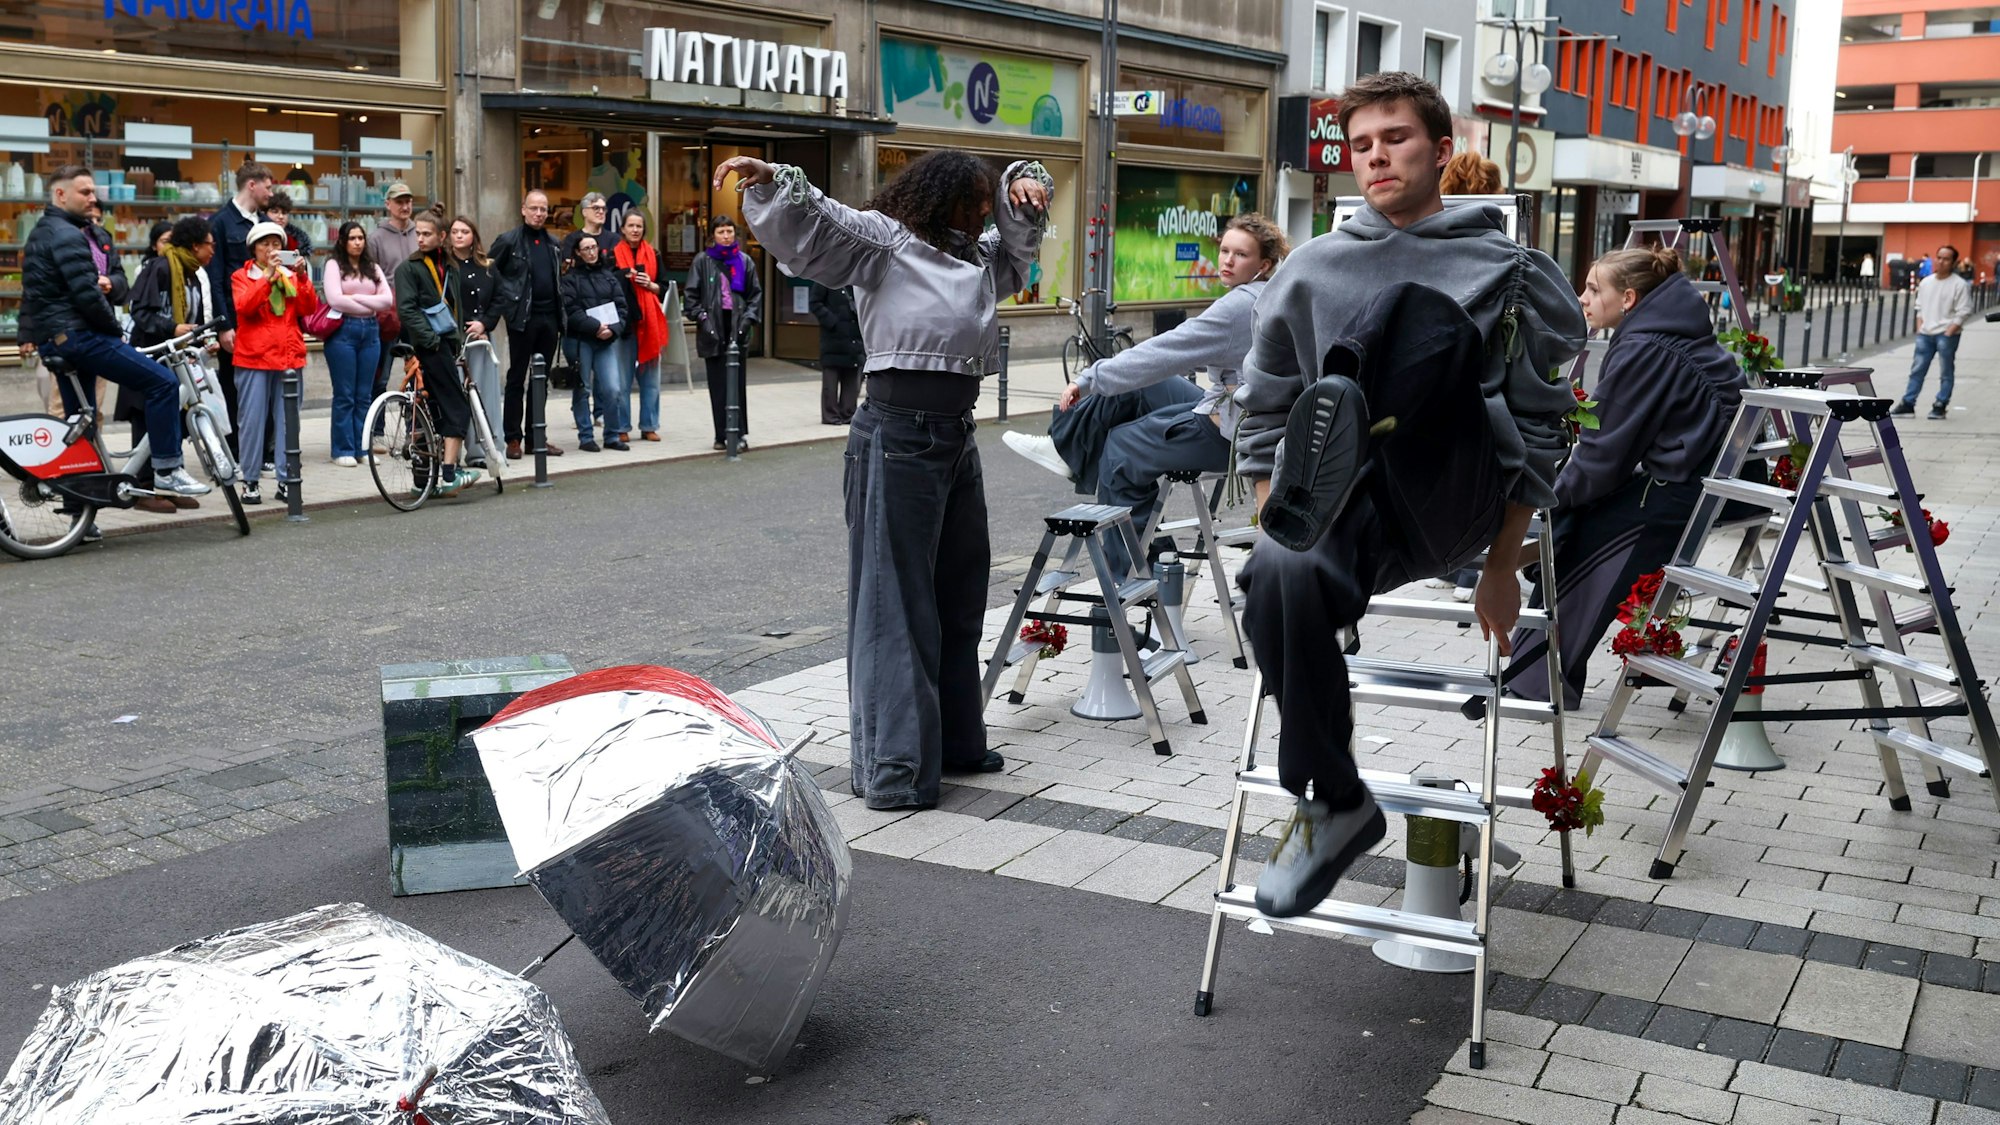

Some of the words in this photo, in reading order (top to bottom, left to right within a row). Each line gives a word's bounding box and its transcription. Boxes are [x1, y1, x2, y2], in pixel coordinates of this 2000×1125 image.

[648, 27, 848, 98] NATURATA
[1322, 144, 1341, 165] 68
[1158, 205, 1217, 238] NATURATA
[9, 433, 33, 446] KVB
